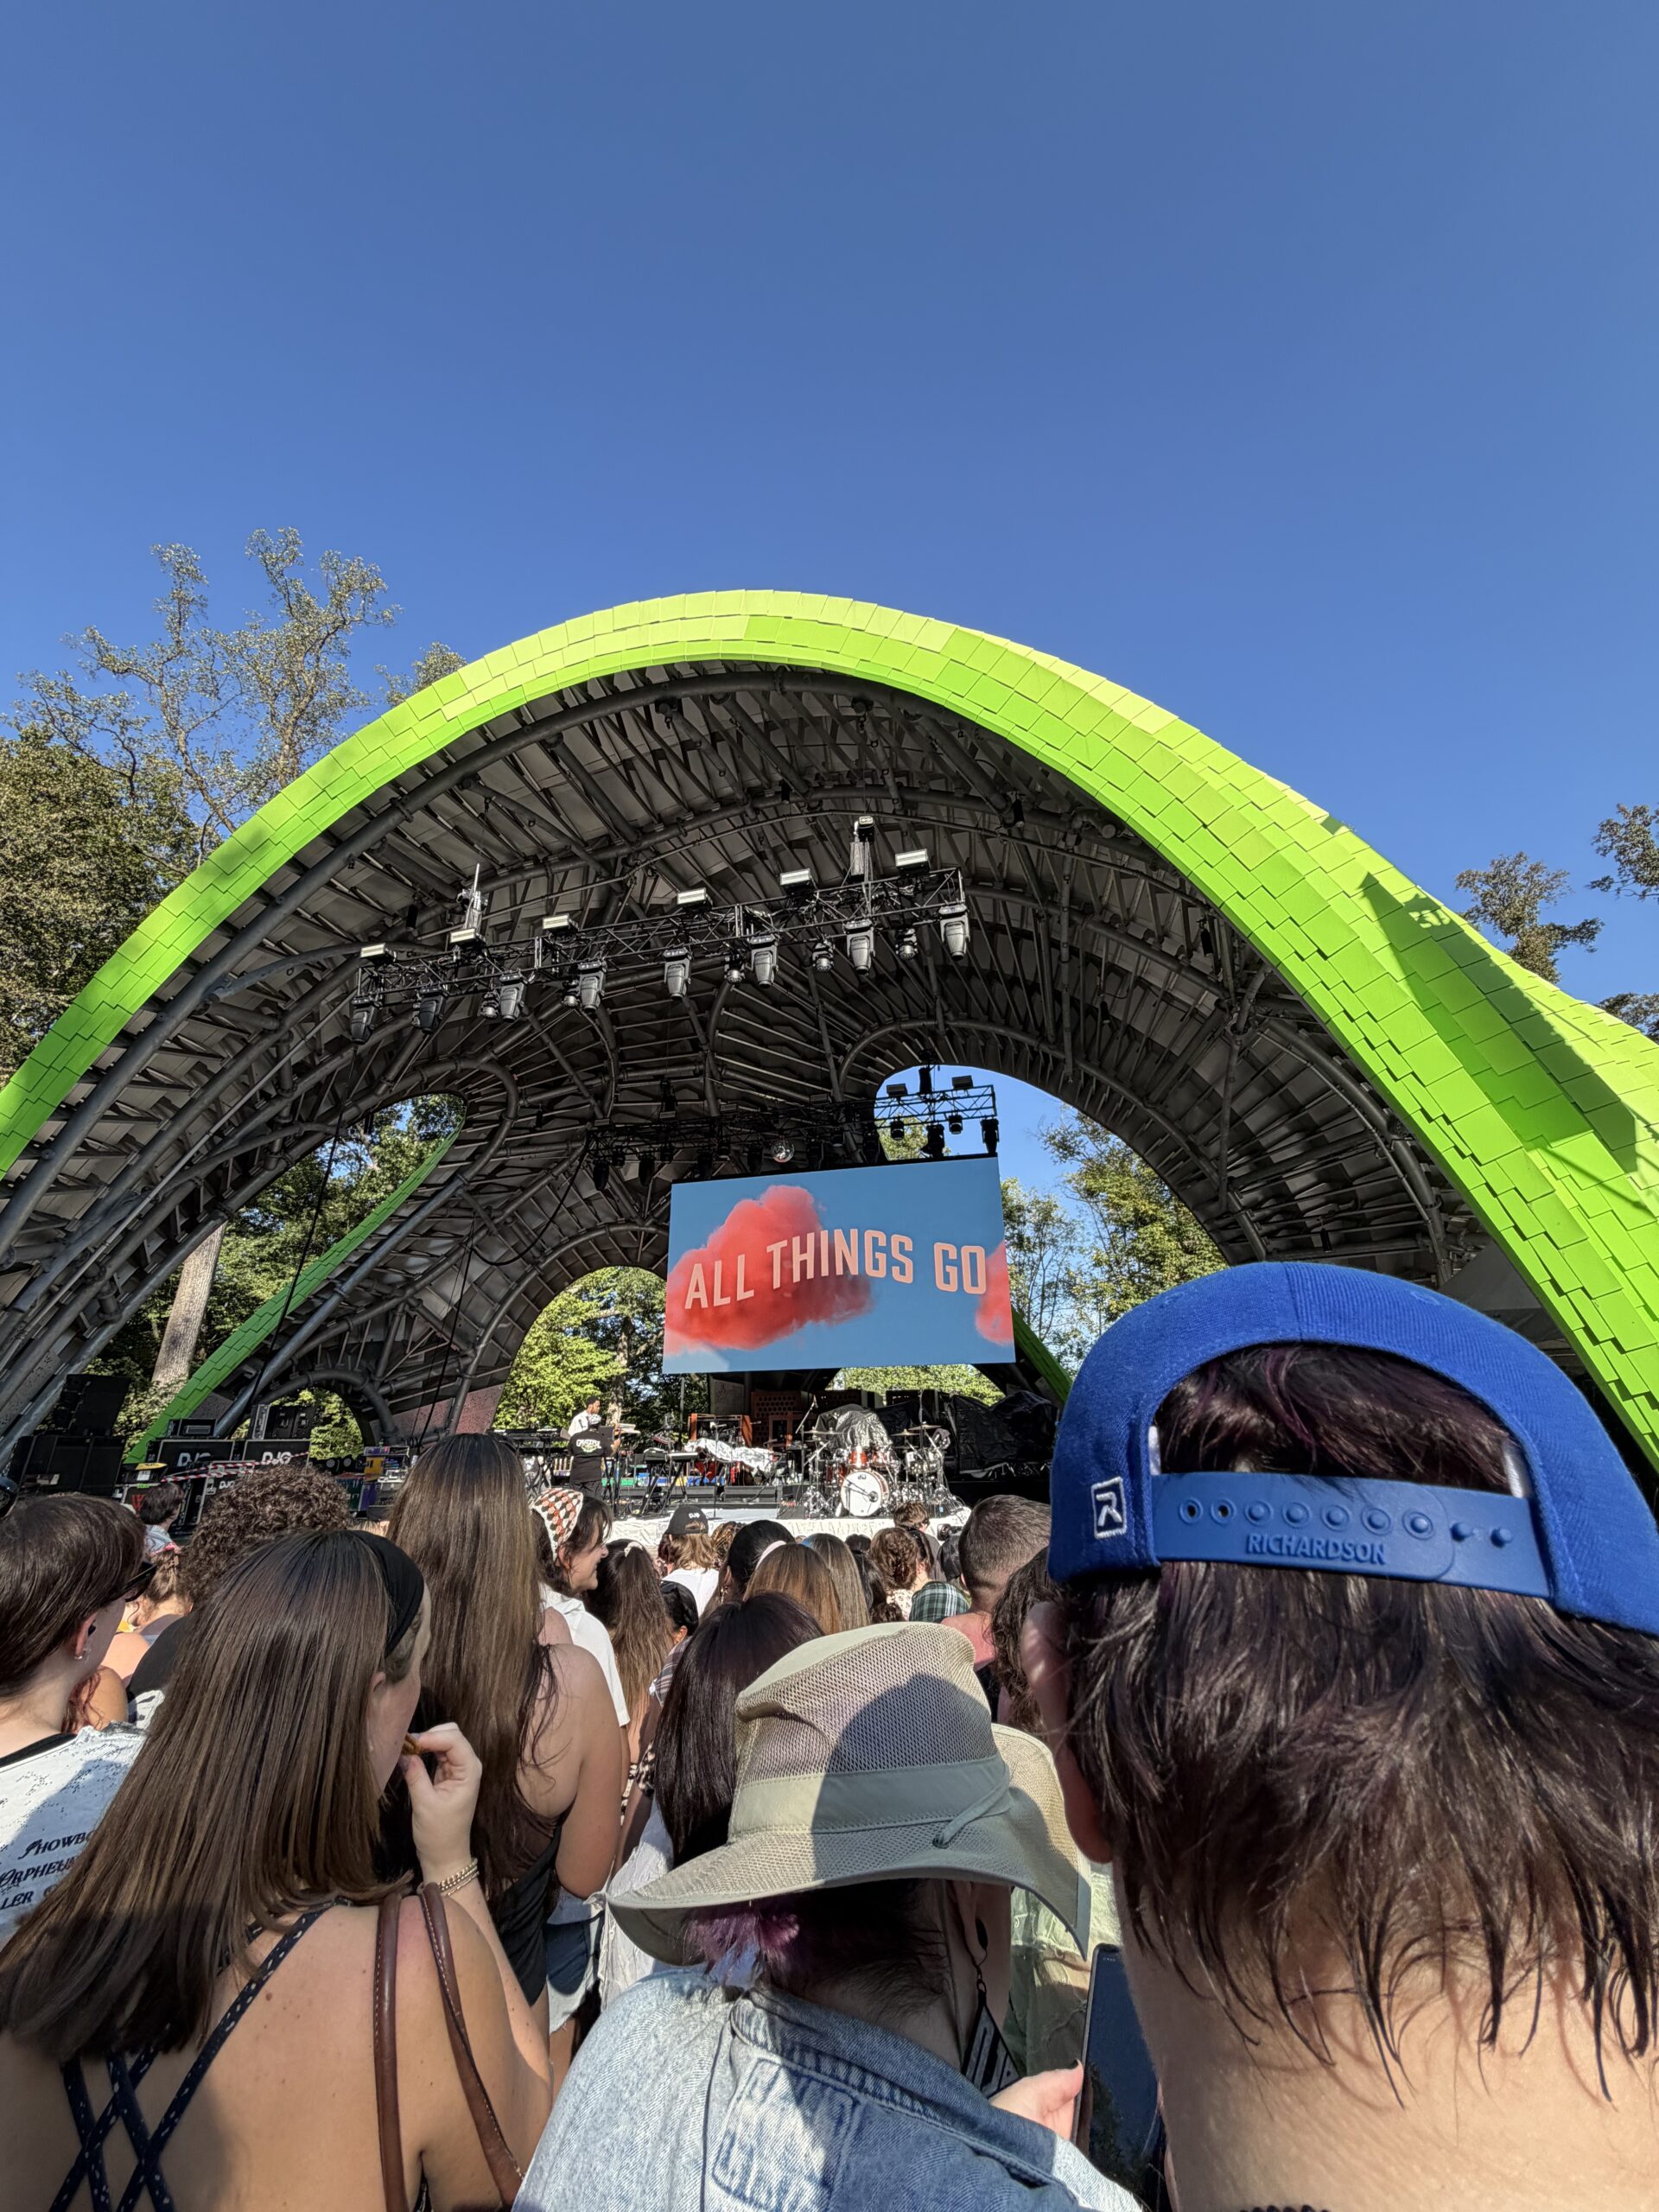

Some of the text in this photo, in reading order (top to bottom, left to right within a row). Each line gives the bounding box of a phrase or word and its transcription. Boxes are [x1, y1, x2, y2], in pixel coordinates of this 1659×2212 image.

[684, 1228, 987, 1310] ALL THINGS GO
[1246, 1533, 1386, 1565] RICHARDSON
